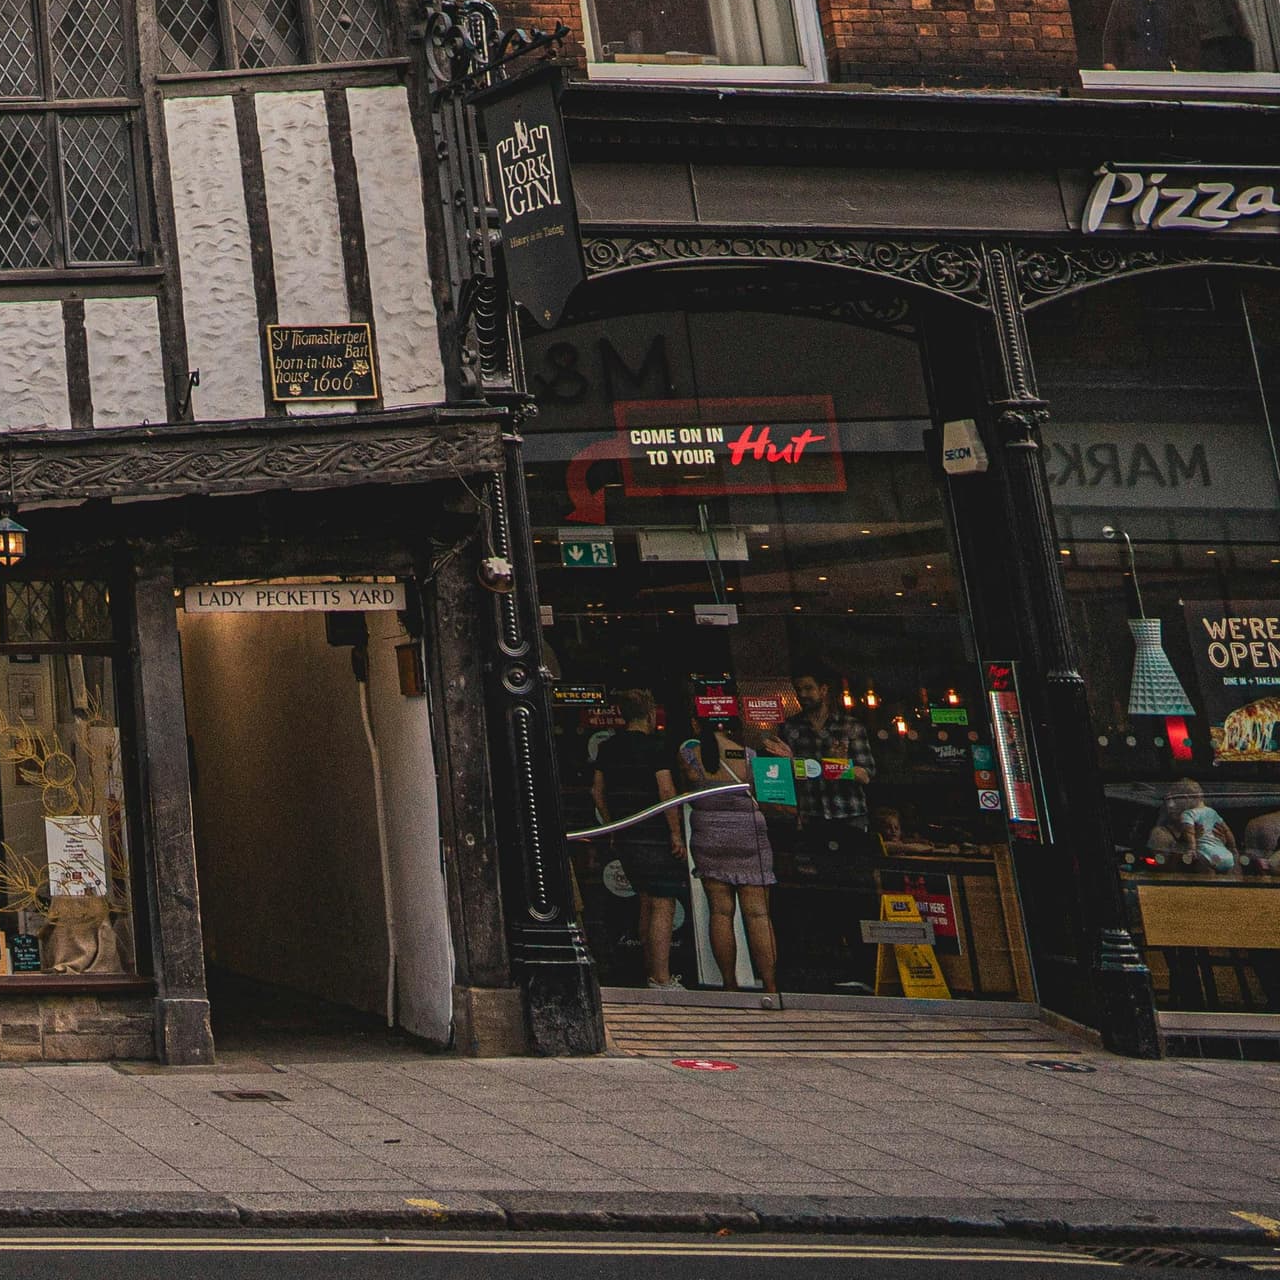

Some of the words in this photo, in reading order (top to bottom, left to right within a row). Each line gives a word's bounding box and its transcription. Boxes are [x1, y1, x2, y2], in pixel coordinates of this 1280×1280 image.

[504, 154, 551, 188] YORK
[510, 175, 552, 216] GIN
[1085, 173, 1280, 232] Pizza
[291, 330, 330, 350] Thomas
[326, 328, 367, 345] Herbert
[313, 371, 353, 392] 1606
[630, 429, 675, 445] COME
[679, 429, 702, 444] ON
[706, 428, 724, 443] IN
[727, 424, 826, 466] Hut
[646, 450, 668, 465] TO
[671, 449, 715, 465] YOUR
[198, 591, 245, 607] LADY
[349, 589, 394, 606] YARD
[1202, 617, 1280, 640] WE'RE
[581, 691, 602, 699] OPEN
